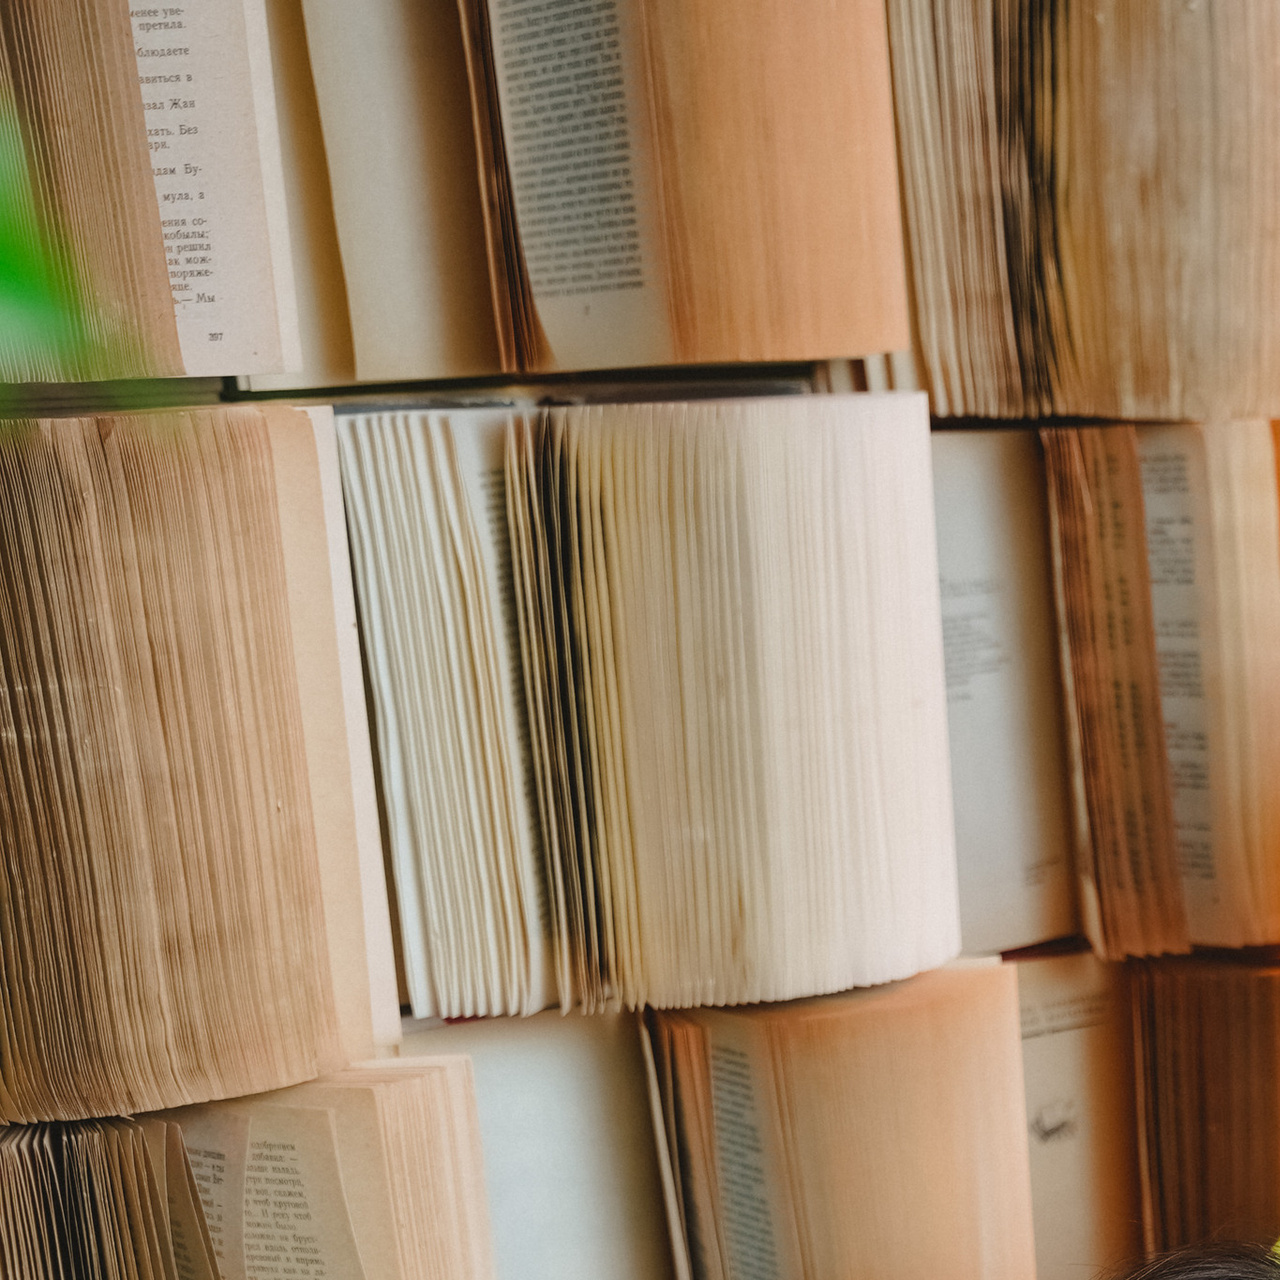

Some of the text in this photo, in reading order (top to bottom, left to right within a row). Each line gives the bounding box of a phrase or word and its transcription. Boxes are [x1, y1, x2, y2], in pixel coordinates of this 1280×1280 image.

[162, 7, 185, 19] уве-
[138, 20, 187, 33] претила.
[136, 47, 190, 58] блюдаете
[168, 97, 196, 111] Жан
[179, 124, 199, 136] Без
[183, 163, 202, 176] Бу-
[192, 217, 208, 226] со-
[176, 243, 212, 255] решил
[186, 256, 212, 265] мож-
[170, 269, 214, 281] поряже-
[196, 292, 216, 304] Мы
